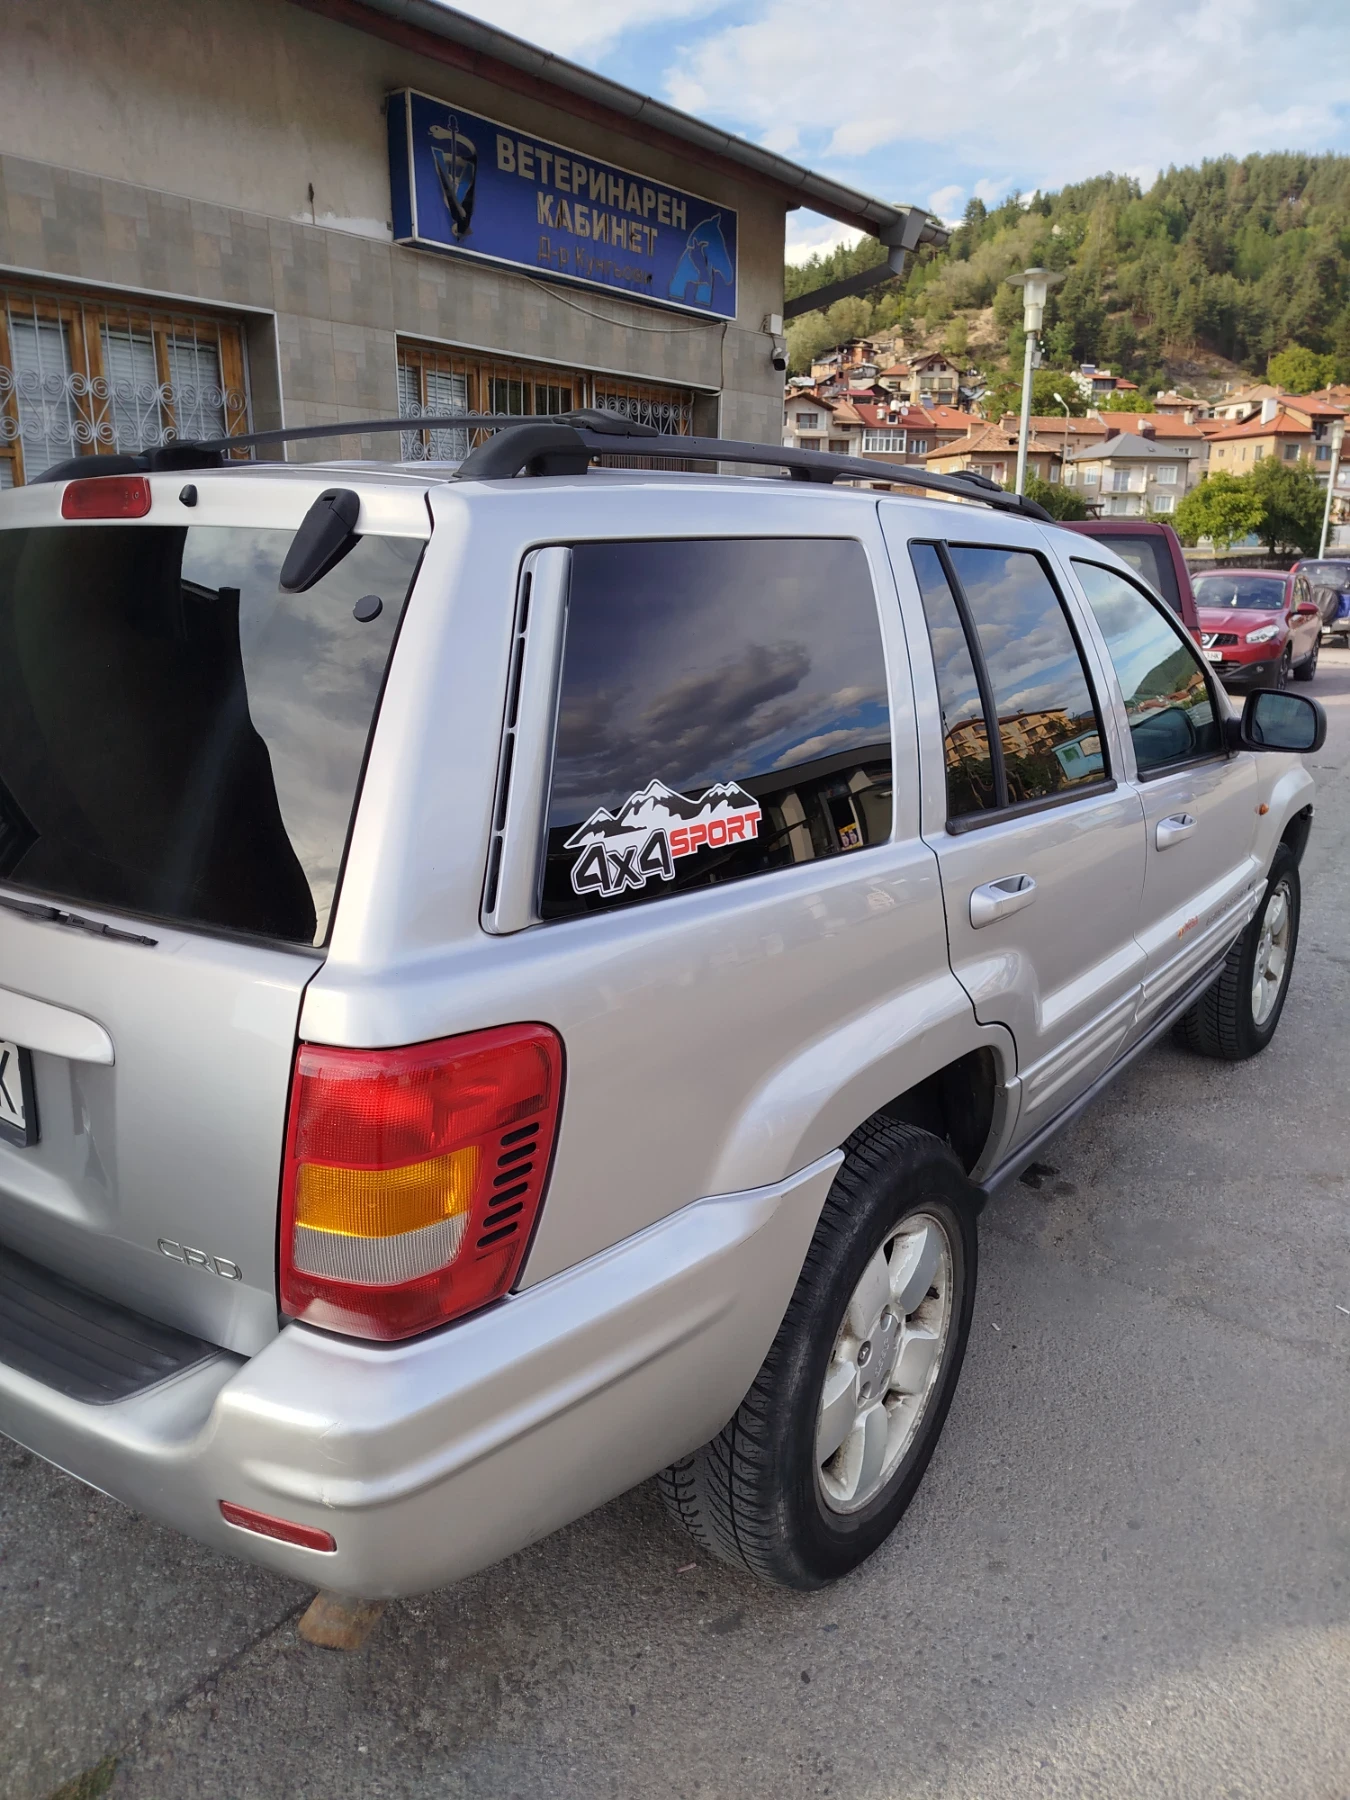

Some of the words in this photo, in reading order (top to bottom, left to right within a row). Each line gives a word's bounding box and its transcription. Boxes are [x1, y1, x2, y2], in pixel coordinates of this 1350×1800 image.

[496, 134, 687, 230] ВЕТЕРИНАРЕН
[536, 191, 658, 257] КАБИНЕТ
[572, 828, 675, 895] 4x4
[669, 810, 761, 858] SPORT
[157, 1238, 242, 1281] CRD
